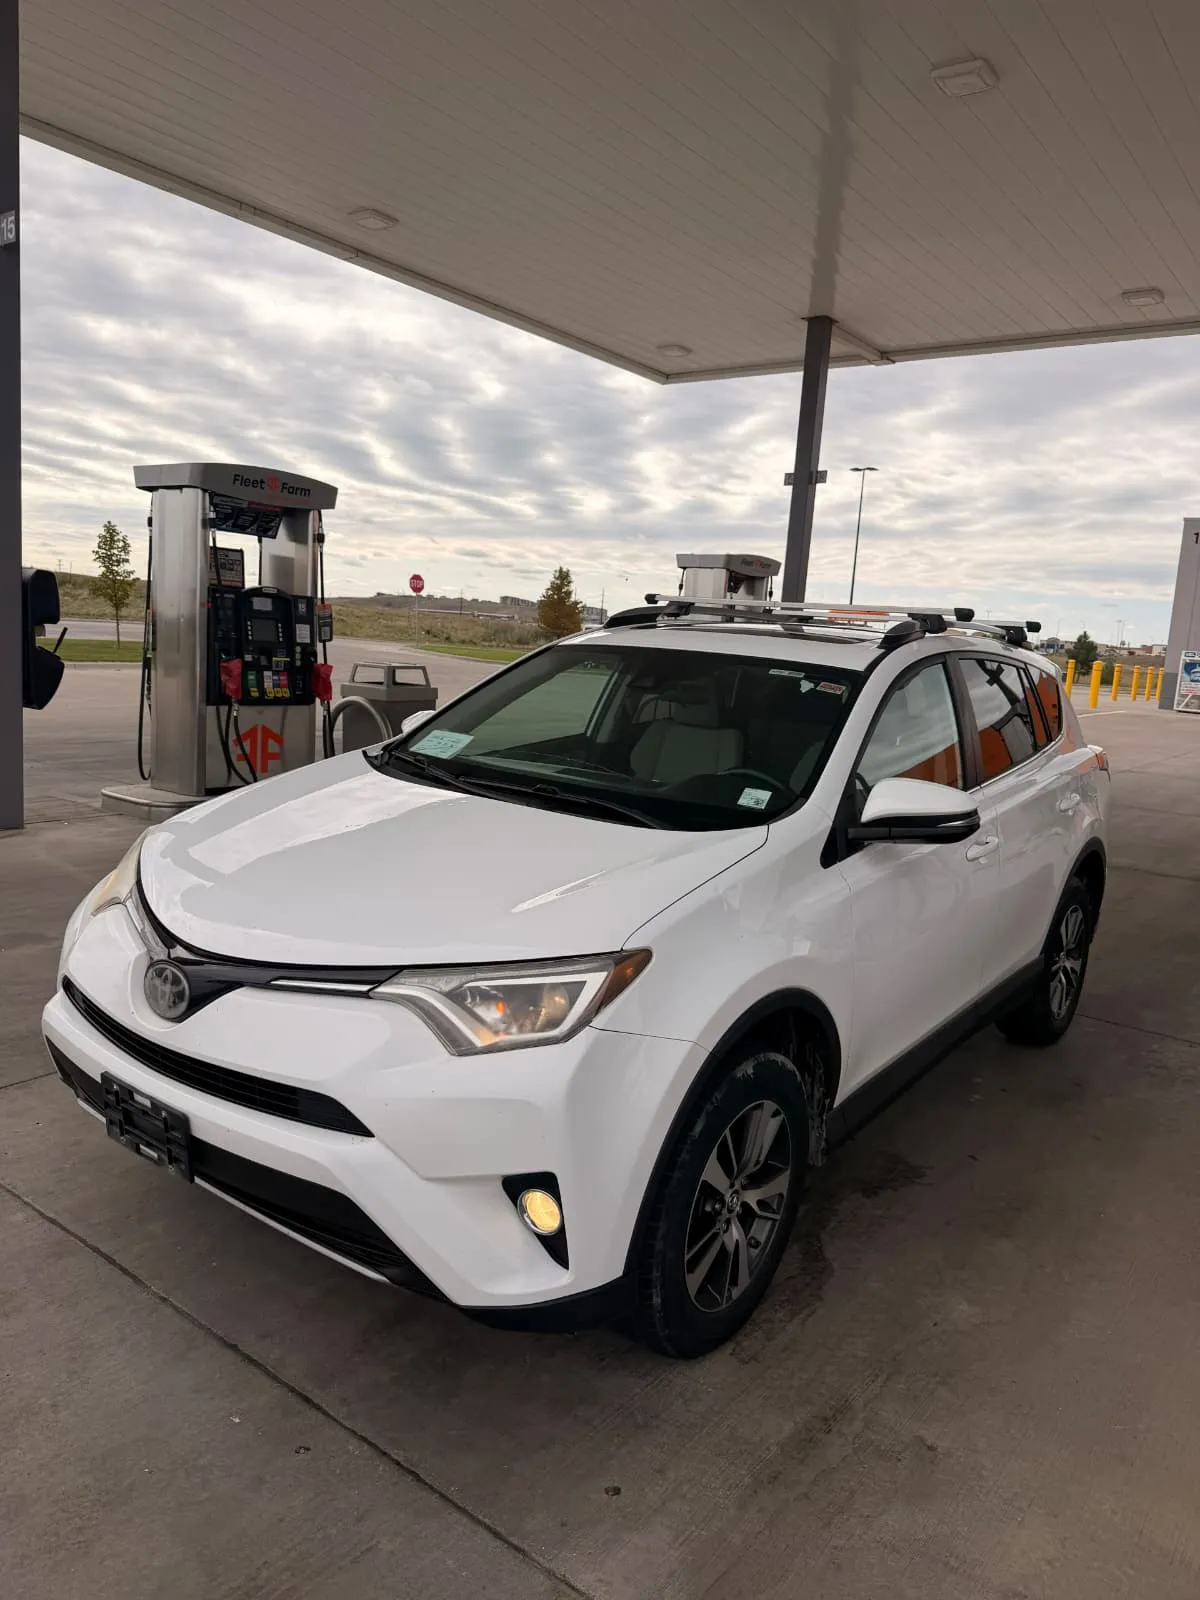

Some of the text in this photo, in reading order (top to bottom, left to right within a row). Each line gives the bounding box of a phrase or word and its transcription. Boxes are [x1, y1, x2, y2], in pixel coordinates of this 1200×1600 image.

[1, 215, 15, 241] 15
[232, 473, 311, 497] Fleet Farm
[410, 579, 424, 588] STOP
